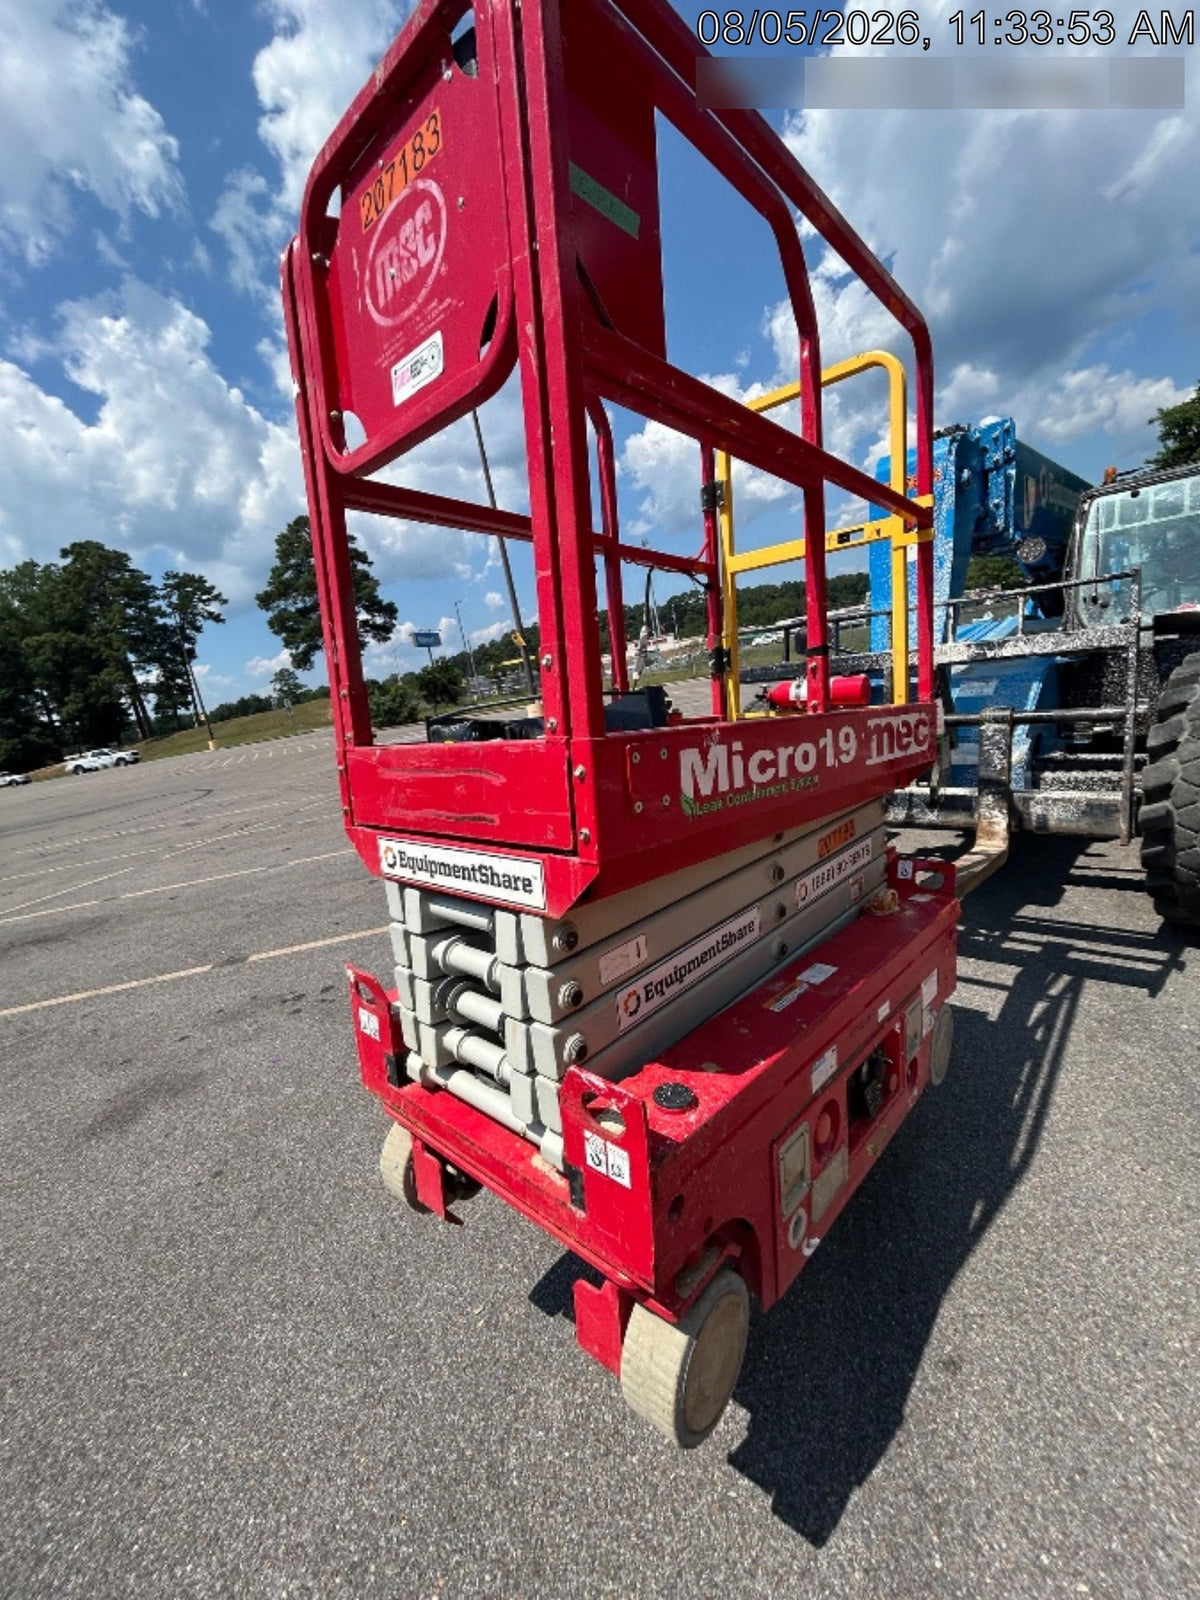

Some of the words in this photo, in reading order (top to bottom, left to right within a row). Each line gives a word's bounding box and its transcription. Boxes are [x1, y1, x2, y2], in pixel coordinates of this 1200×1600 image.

[362, 113, 440, 231] 207183
[397, 850, 534, 895] EquipmentShare
[643, 921, 756, 1001] EquipmentShare
